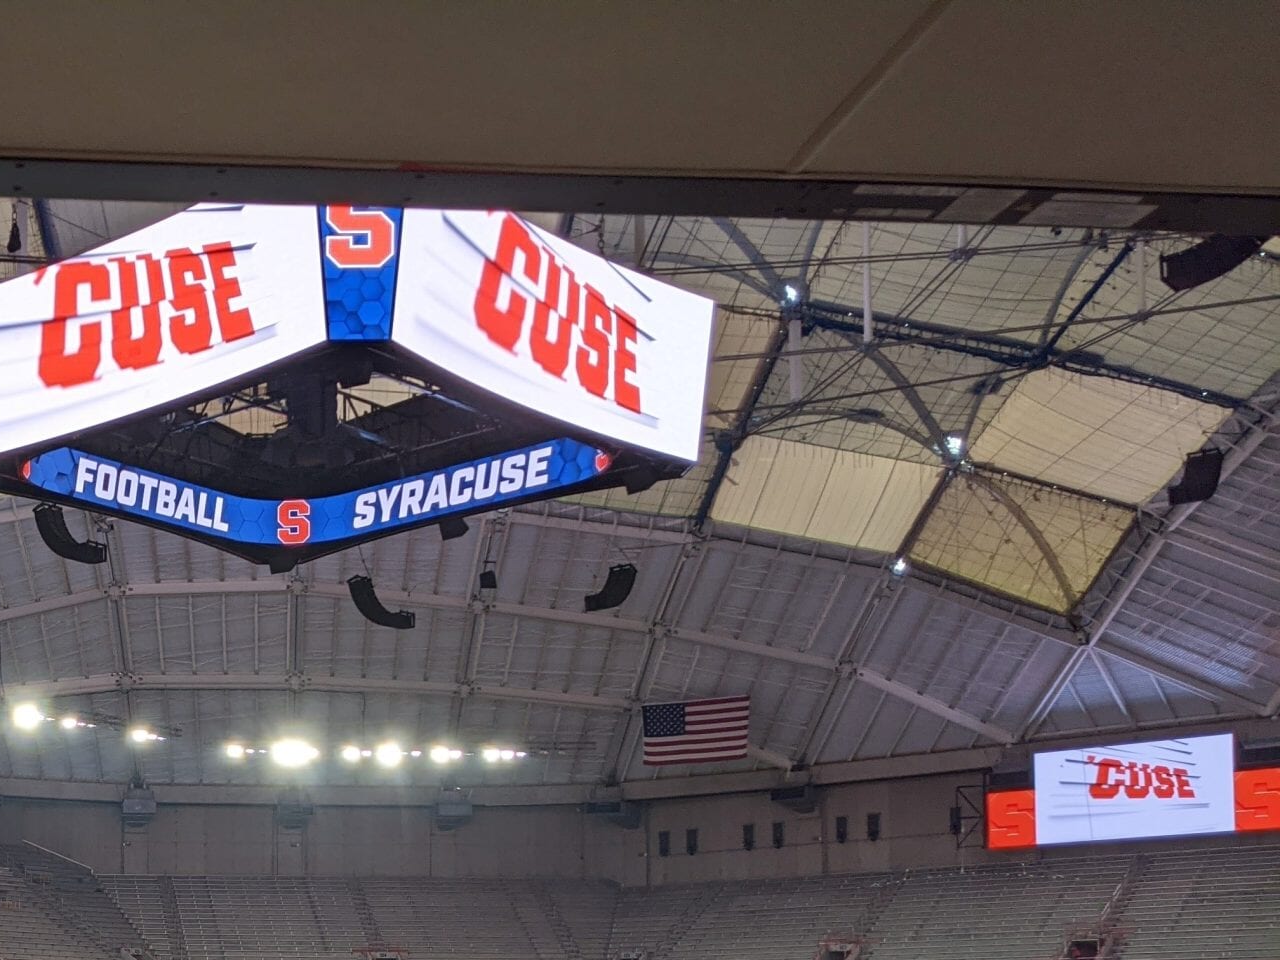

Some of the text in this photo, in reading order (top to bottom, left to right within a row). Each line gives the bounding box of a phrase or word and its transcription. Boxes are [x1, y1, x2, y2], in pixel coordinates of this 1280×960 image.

[326, 206, 395, 268] S
[75, 457, 229, 532] FOOTBALL
[276, 499, 311, 545] S
[353, 447, 553, 529] SYRACUSE
